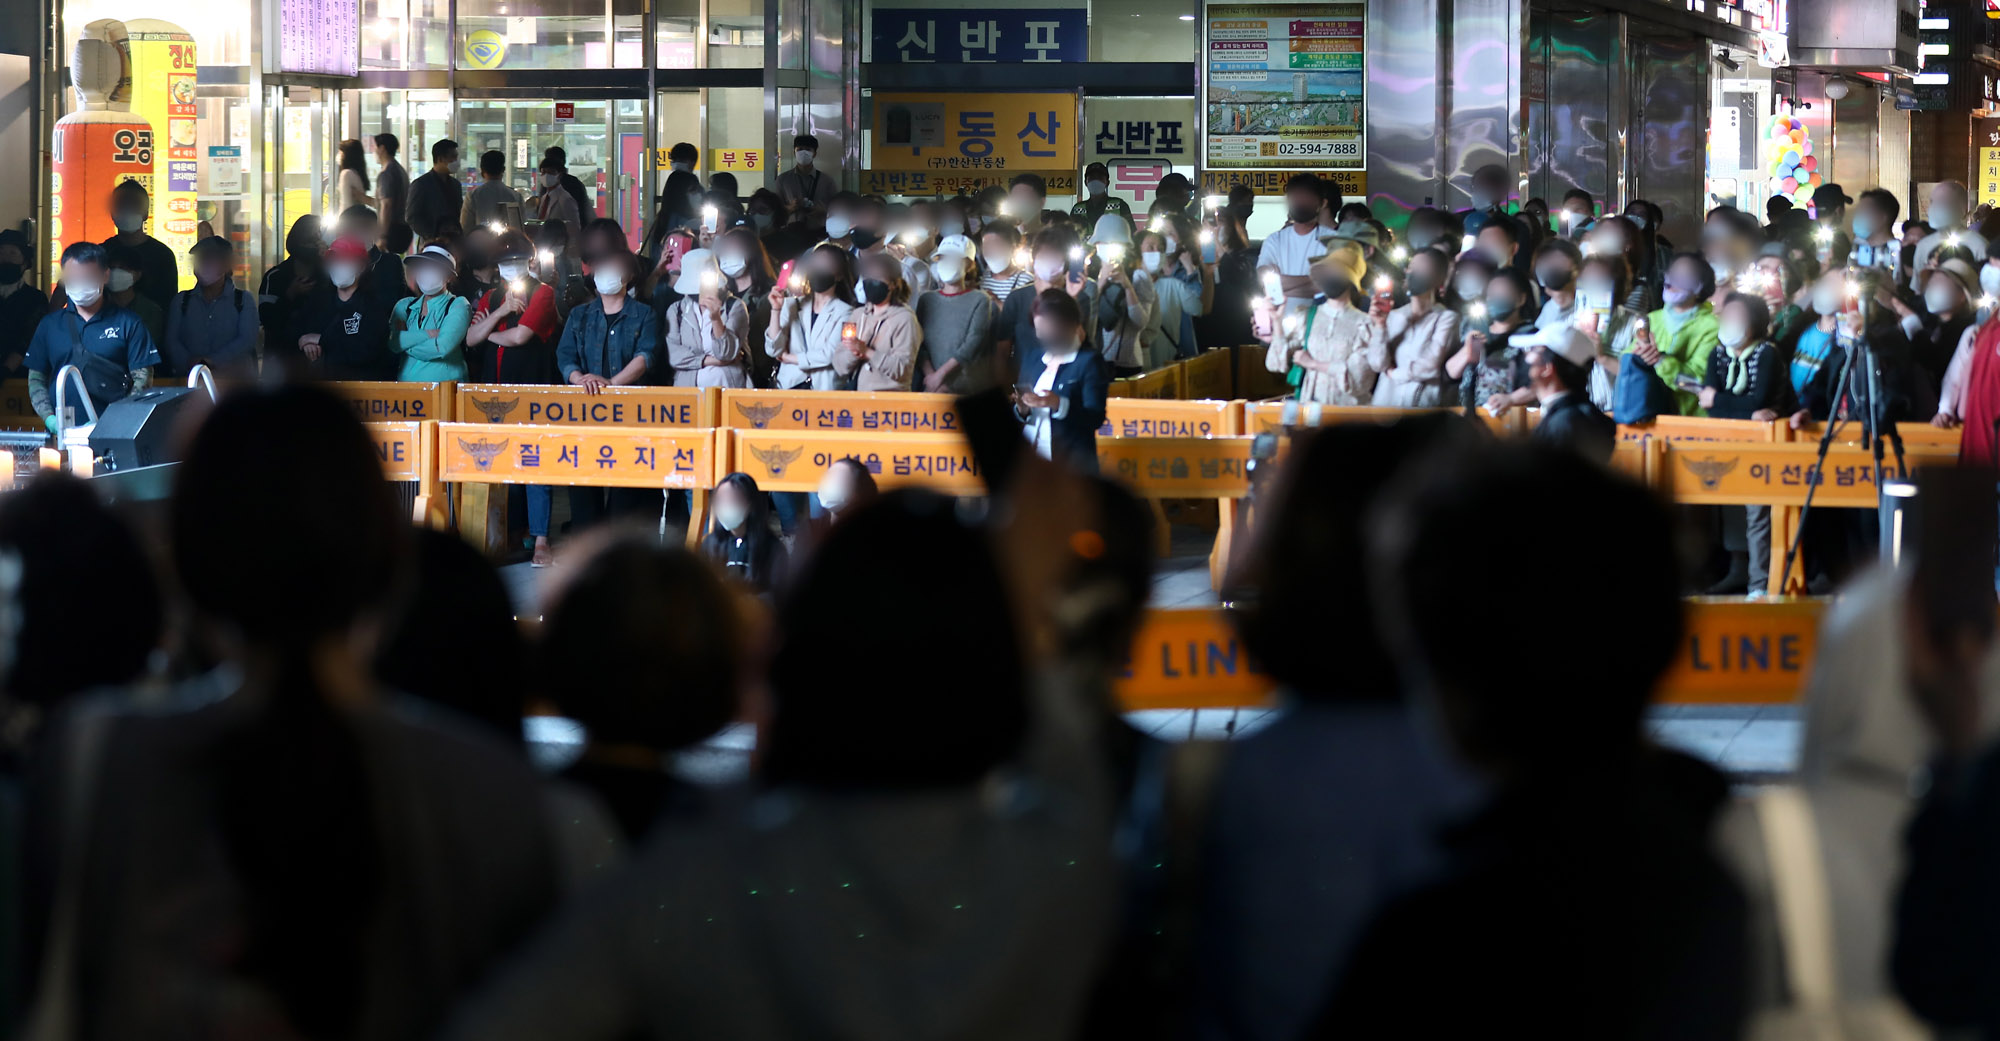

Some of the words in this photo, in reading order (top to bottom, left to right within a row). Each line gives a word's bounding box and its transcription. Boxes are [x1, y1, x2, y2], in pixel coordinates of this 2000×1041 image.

[896, 20, 1062, 63] 신반포
[168, 44, 197, 69] 정선
[911, 111, 1061, 158] 동산
[1096, 121, 1183, 155] 신반포
[113, 129, 154, 164] 오공
[1279, 143, 1357, 154] 02-594-7888
[867, 171, 929, 194] 신반포
[353, 399, 427, 418] 지마시오
[529, 402, 624, 422] POLICE
[637, 404, 692, 424] LINE
[792, 408, 809, 427] 이
[817, 408, 853, 428] 선을
[862, 410, 958, 431] 넘지마시오
[374, 441, 405, 462] NE
[519, 443, 695, 472] 질서유지선
[893, 454, 978, 477] 넘지마시
[1200, 458, 1249, 479] 넘지
[1750, 464, 1770, 485] 이
[1780, 464, 1824, 486] 선을
[1161, 639, 1239, 678] LIN
[1690, 635, 1800, 671] LINE
